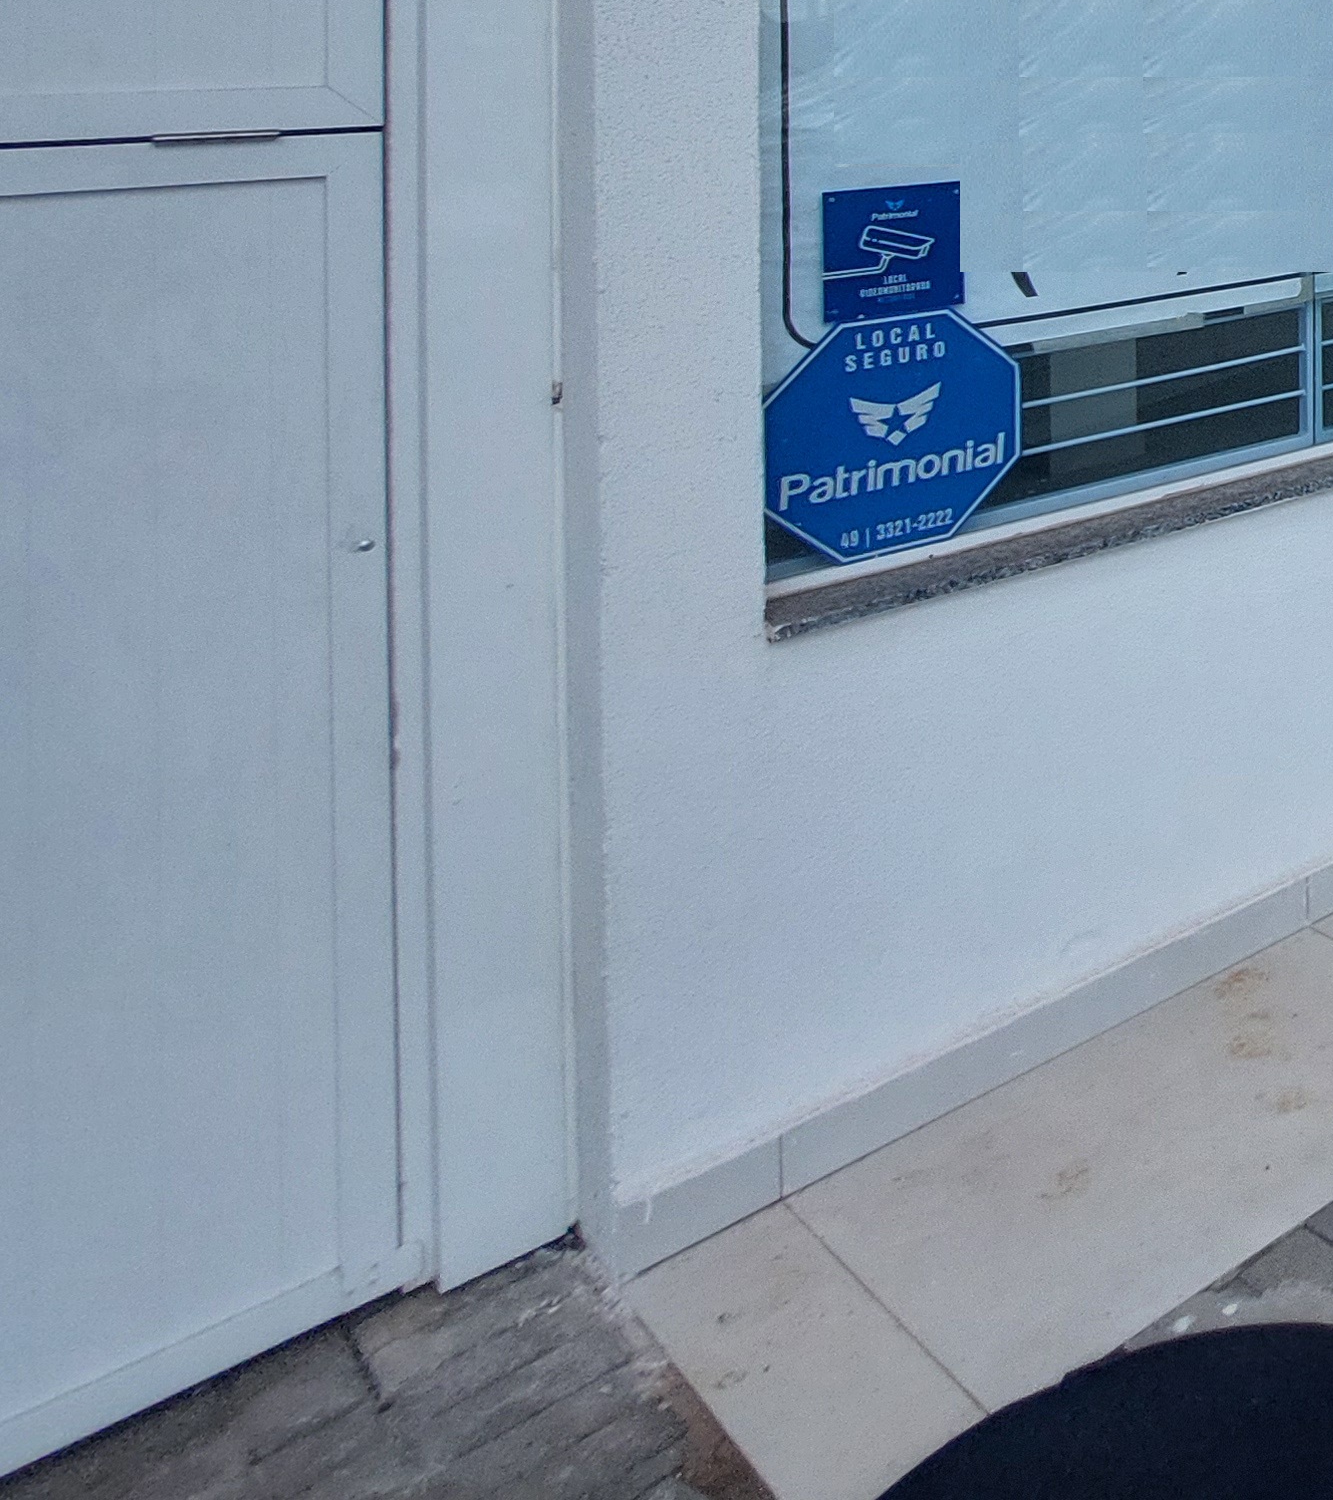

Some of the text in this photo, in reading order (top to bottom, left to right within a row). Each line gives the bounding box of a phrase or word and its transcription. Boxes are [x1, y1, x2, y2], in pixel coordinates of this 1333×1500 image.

[856, 322, 936, 350] LOCAL
[845, 341, 946, 373] SEGURO
[779, 431, 1006, 512] Patrimonial
[876, 508, 954, 541] 3321-2222
